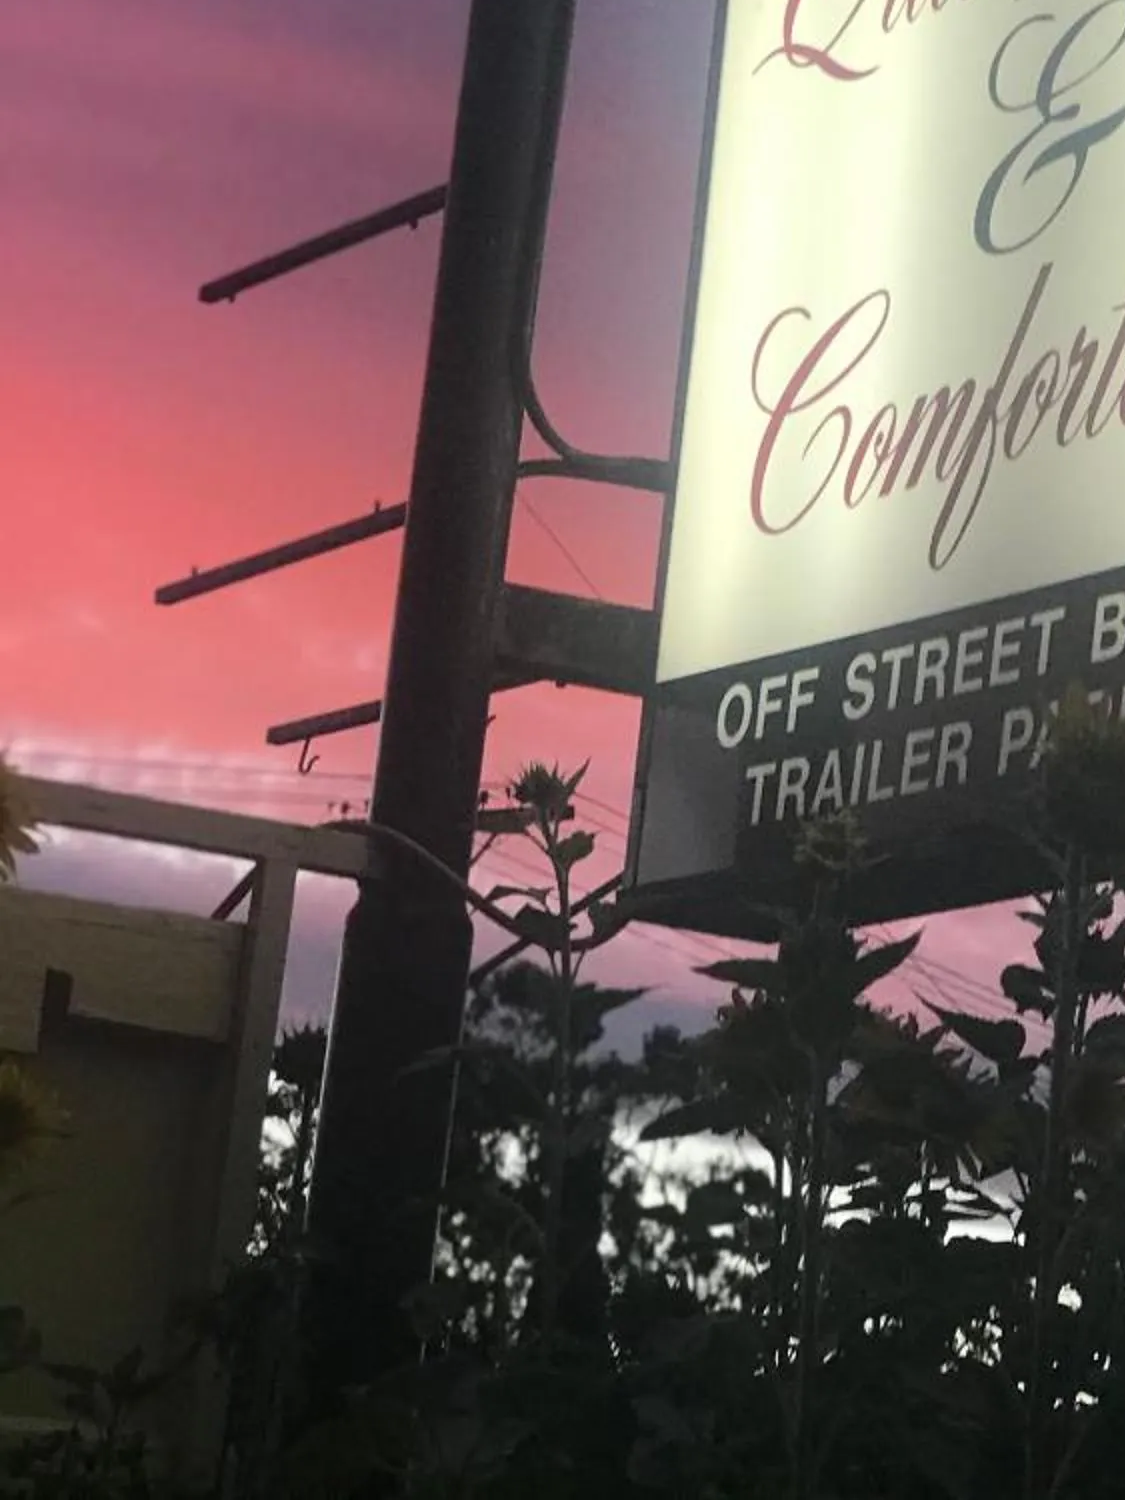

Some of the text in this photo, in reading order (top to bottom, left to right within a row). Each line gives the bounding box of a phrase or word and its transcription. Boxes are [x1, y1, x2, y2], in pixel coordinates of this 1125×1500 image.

[715, 666, 820, 748] OFF
[841, 607, 1066, 722] STREET
[745, 723, 973, 826] TRAILER
